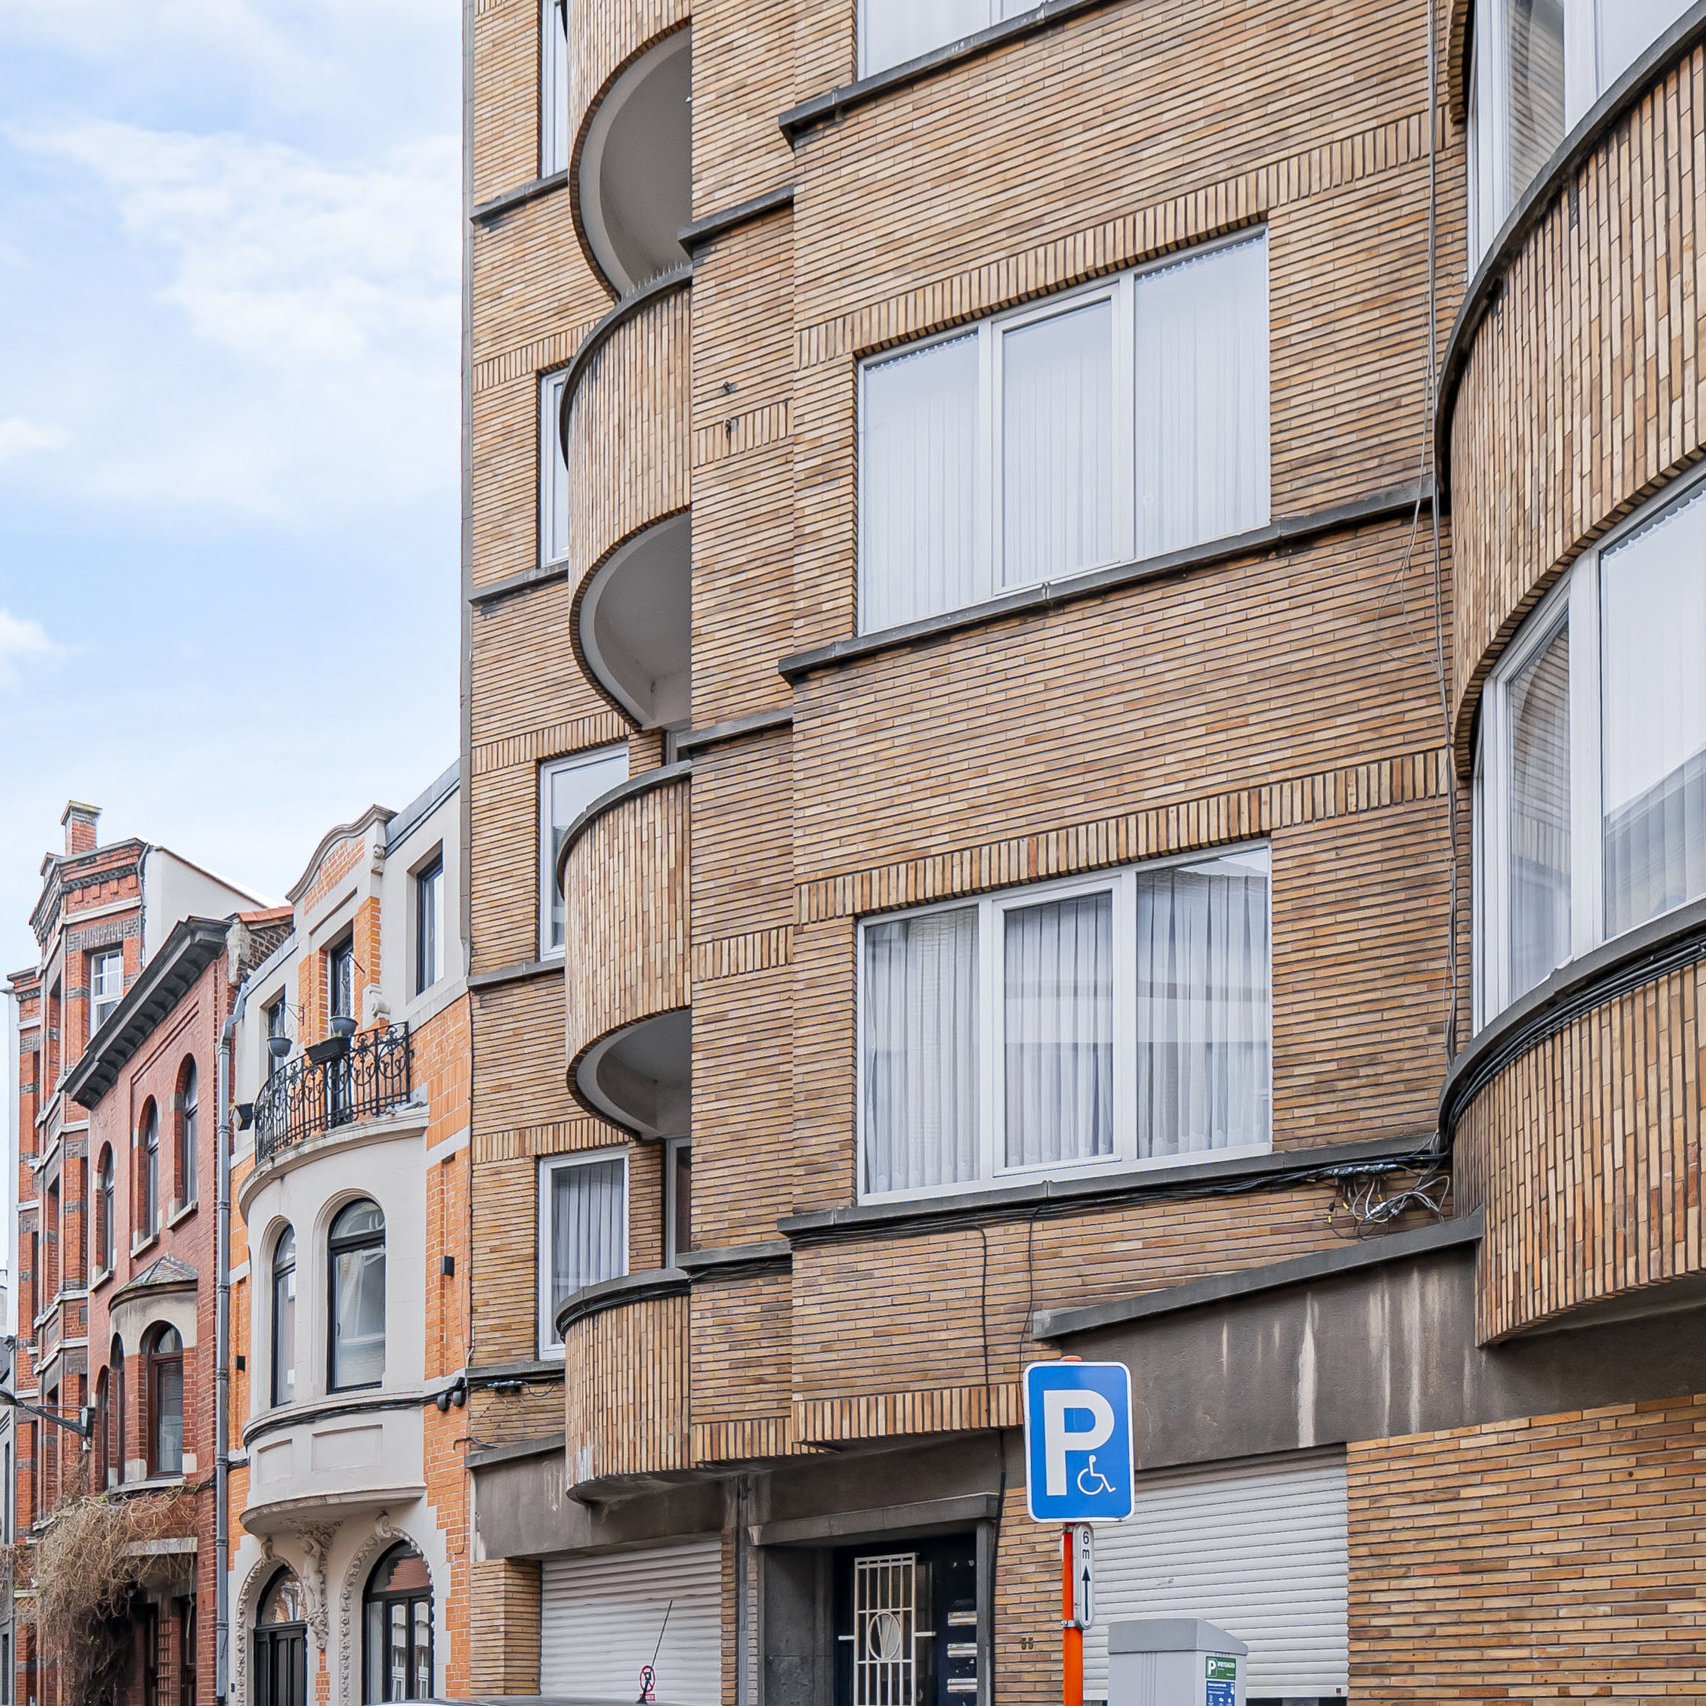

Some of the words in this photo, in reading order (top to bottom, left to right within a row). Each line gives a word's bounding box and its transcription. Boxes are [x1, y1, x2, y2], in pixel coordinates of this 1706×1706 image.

[1043, 1389, 1115, 1496] P
[1082, 1531, 1090, 1544] 6
[1082, 1548, 1091, 1560] m
[1021, 1637, 1034, 1650] 55
[1208, 1660, 1217, 1675] P
